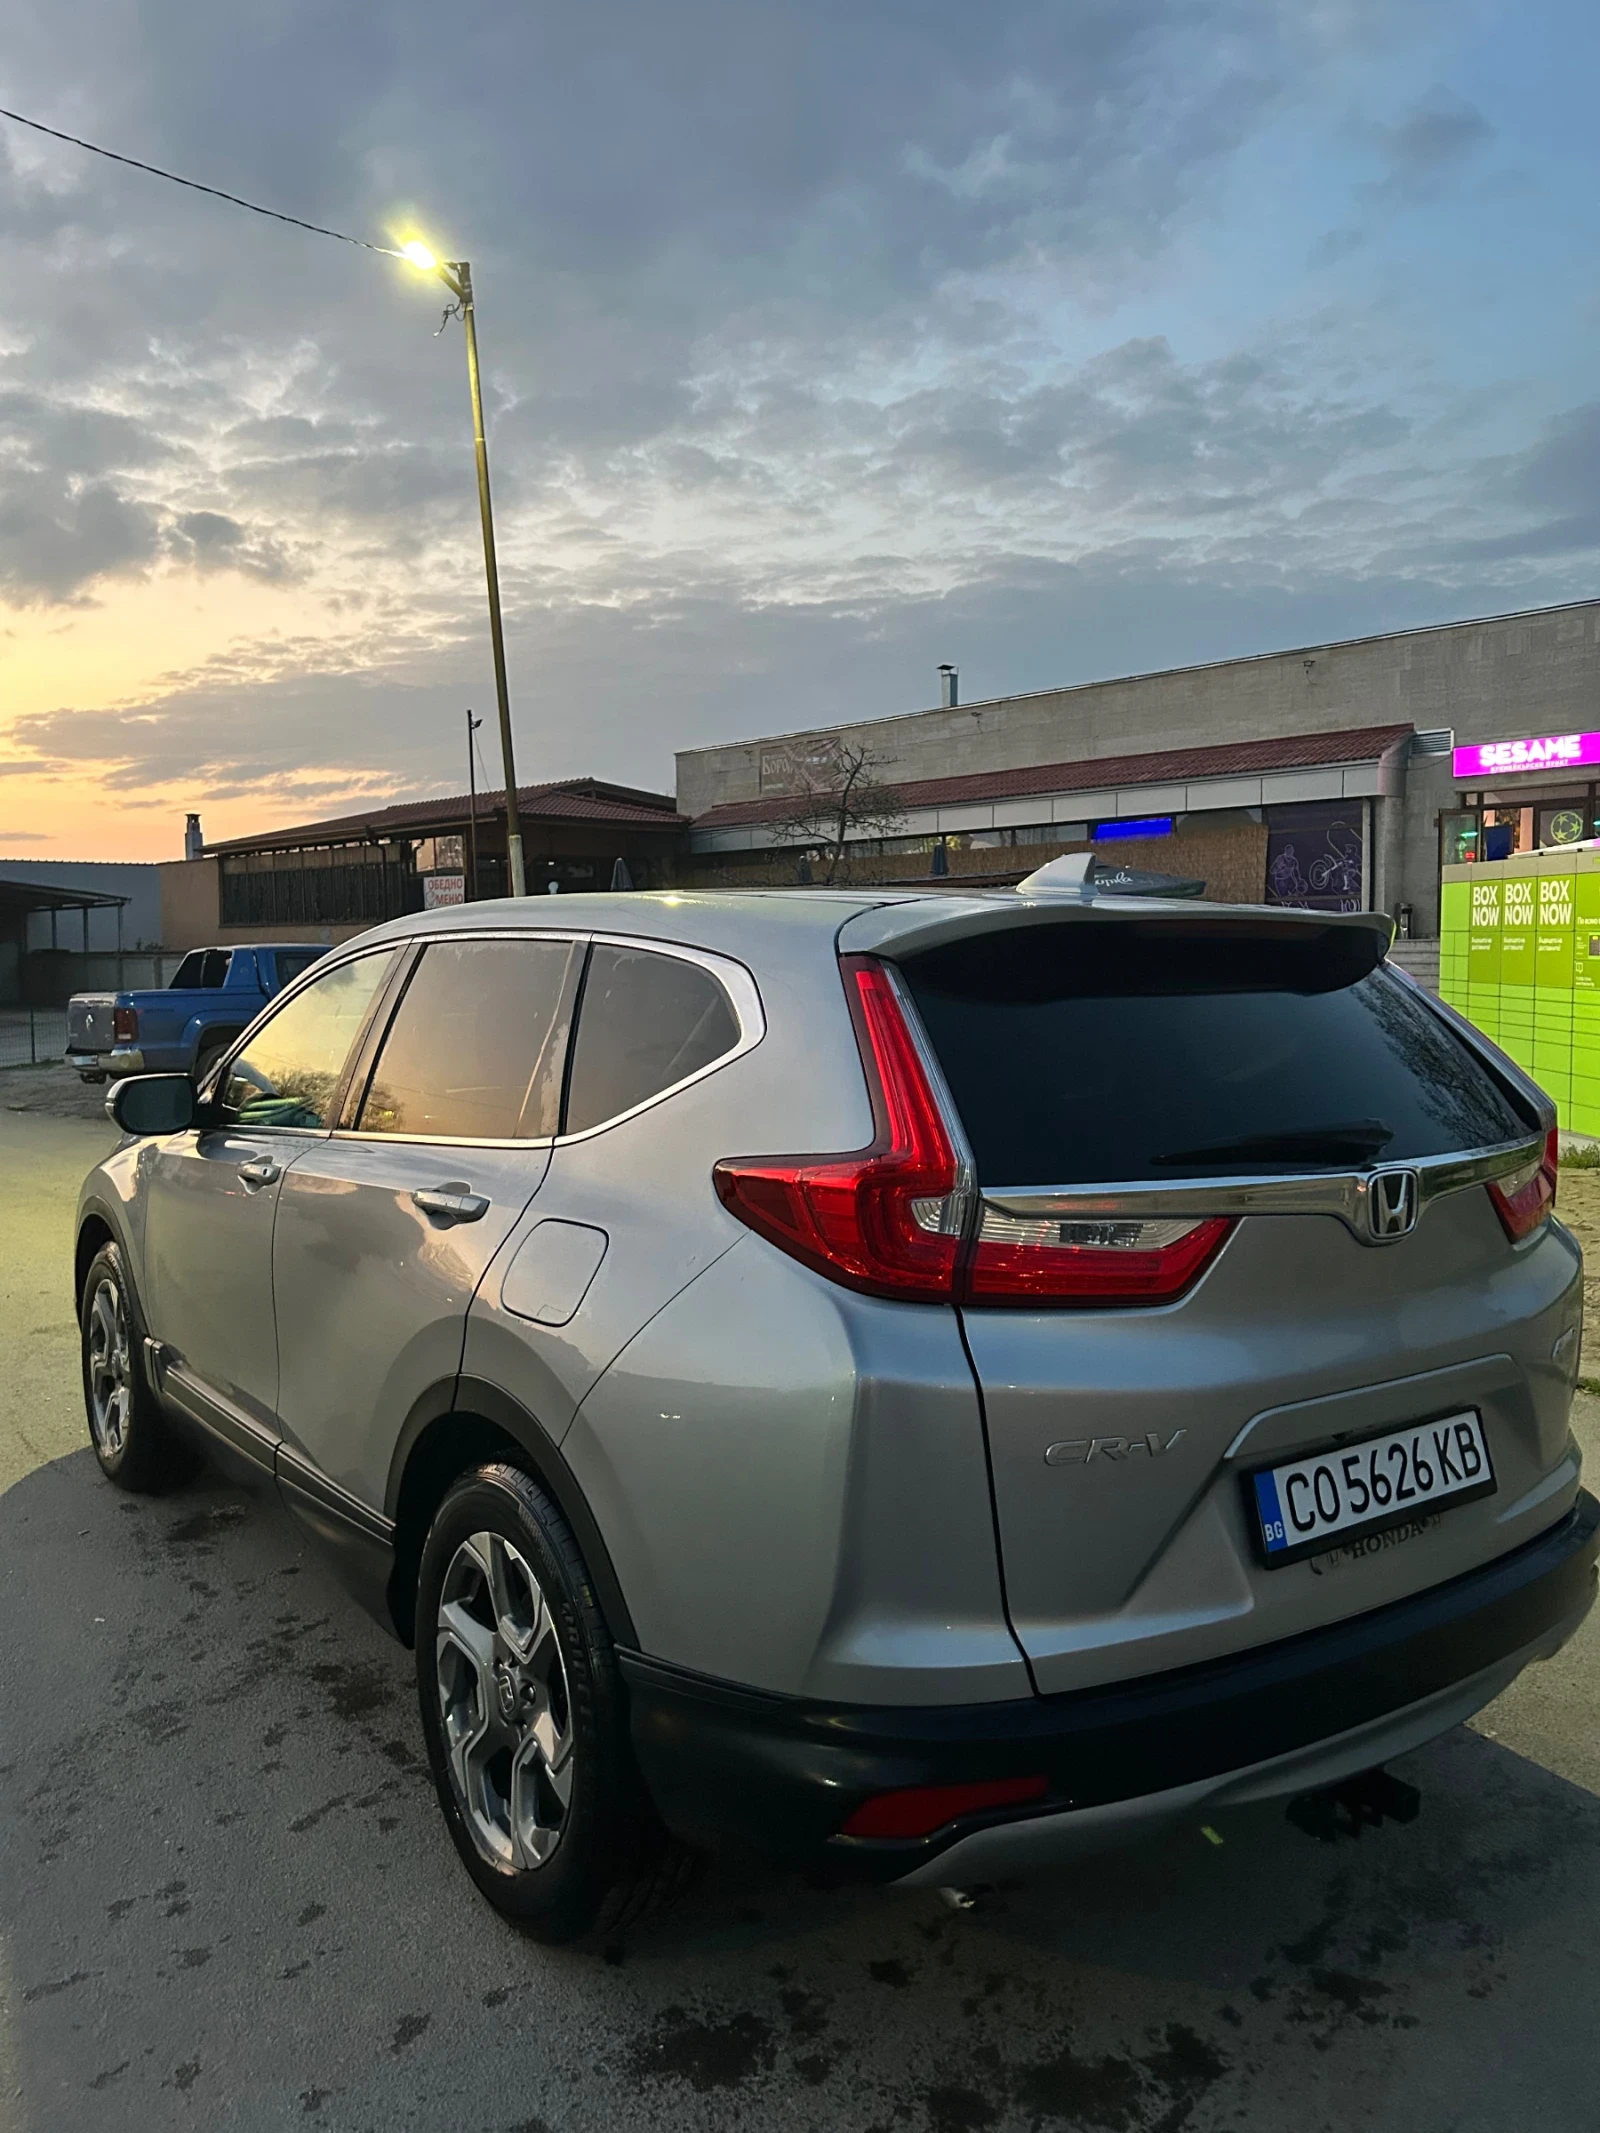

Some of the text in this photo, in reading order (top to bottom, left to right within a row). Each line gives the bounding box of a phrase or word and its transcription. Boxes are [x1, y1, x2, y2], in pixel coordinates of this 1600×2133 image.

[1480, 734, 1582, 767] SESAME
[428, 878, 463, 892] ОБЕДНО
[1473, 886, 1498, 906] BOX
[1505, 882, 1532, 904] BOX
[1540, 880, 1570, 902] BOX
[436, 893, 464, 905] МЕНЮ
[1472, 906, 1500, 926] NOW
[1504, 904, 1534, 925] NOW
[1540, 903, 1573, 925] NOW
[1044, 1429, 1188, 1467] CR-V
[1265, 1520, 1283, 1542] BG
[1352, 1520, 1424, 1559] HONDA
